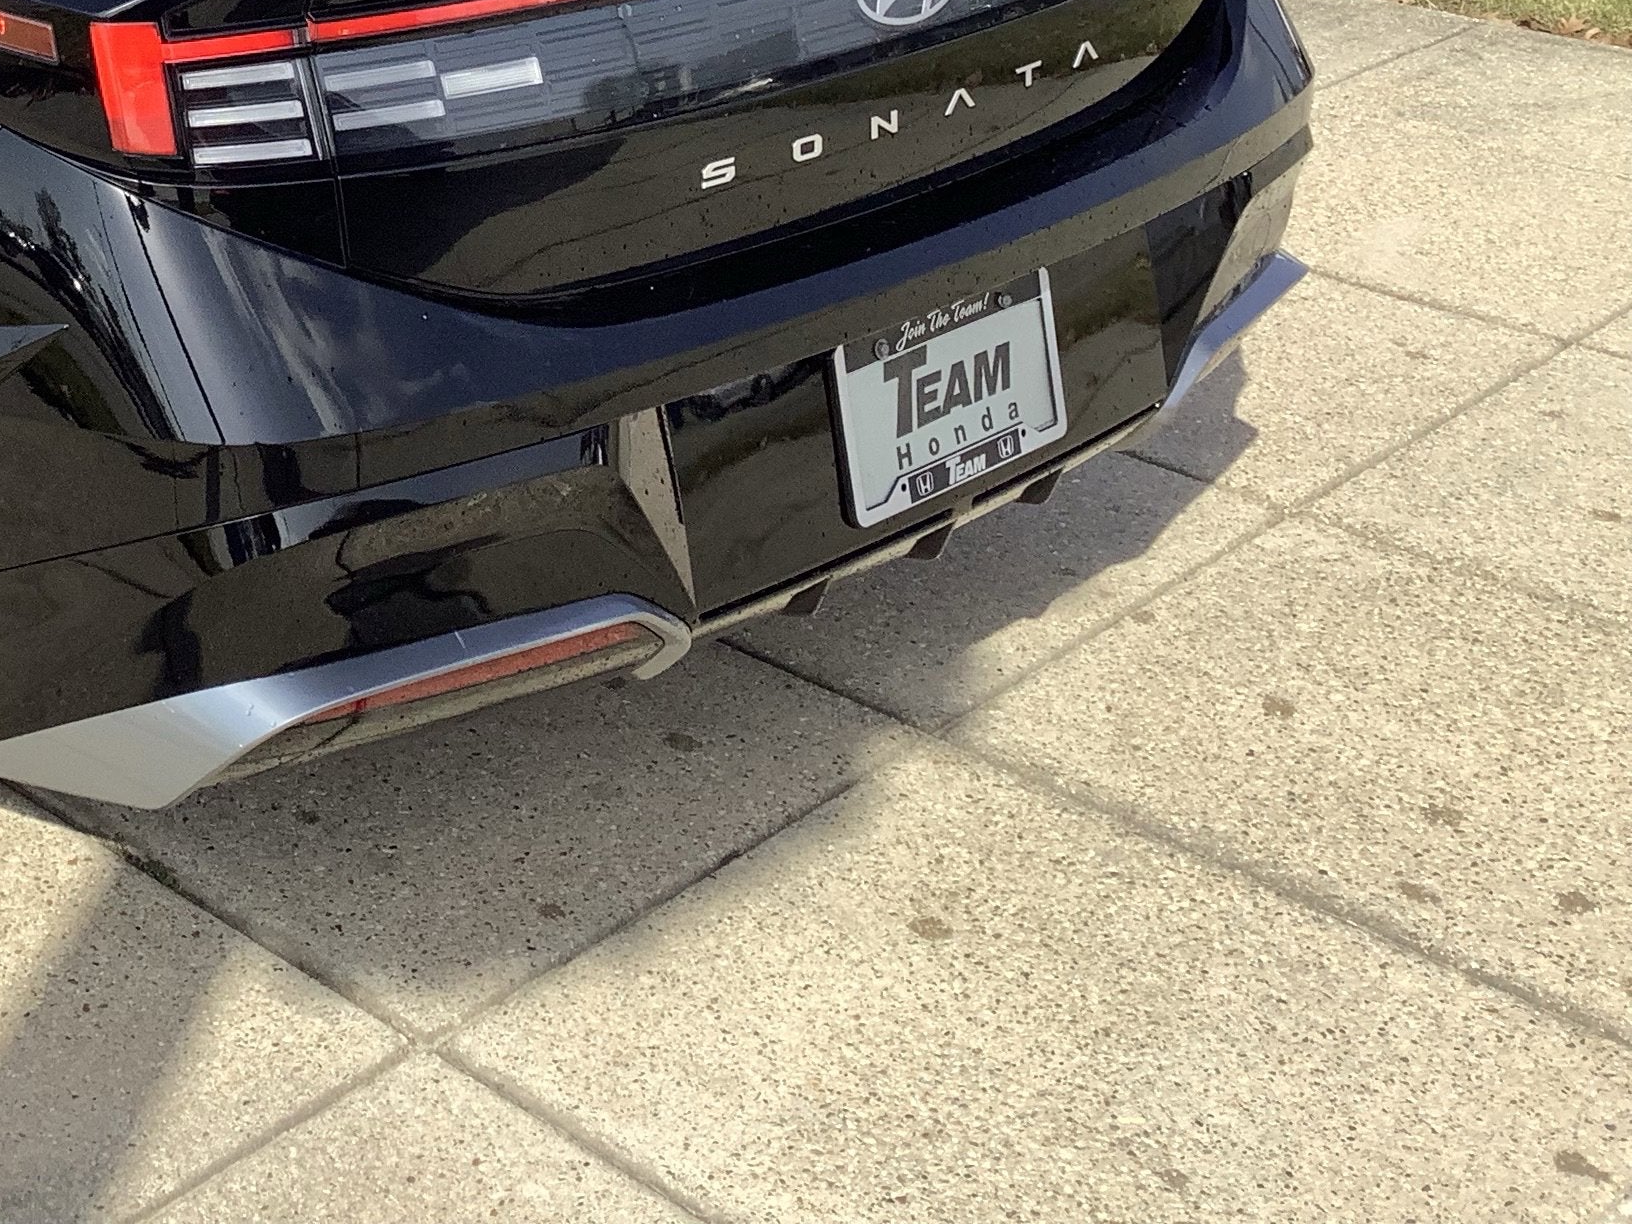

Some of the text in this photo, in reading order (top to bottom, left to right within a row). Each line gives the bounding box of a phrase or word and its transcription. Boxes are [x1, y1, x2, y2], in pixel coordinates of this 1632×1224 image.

[701, 40, 1100, 190] SONATA
[895, 291, 990, 352] Join The Team!
[883, 341, 1010, 439] TEAM
[896, 401, 1020, 471] Honda
[945, 453, 986, 485] TEAM
